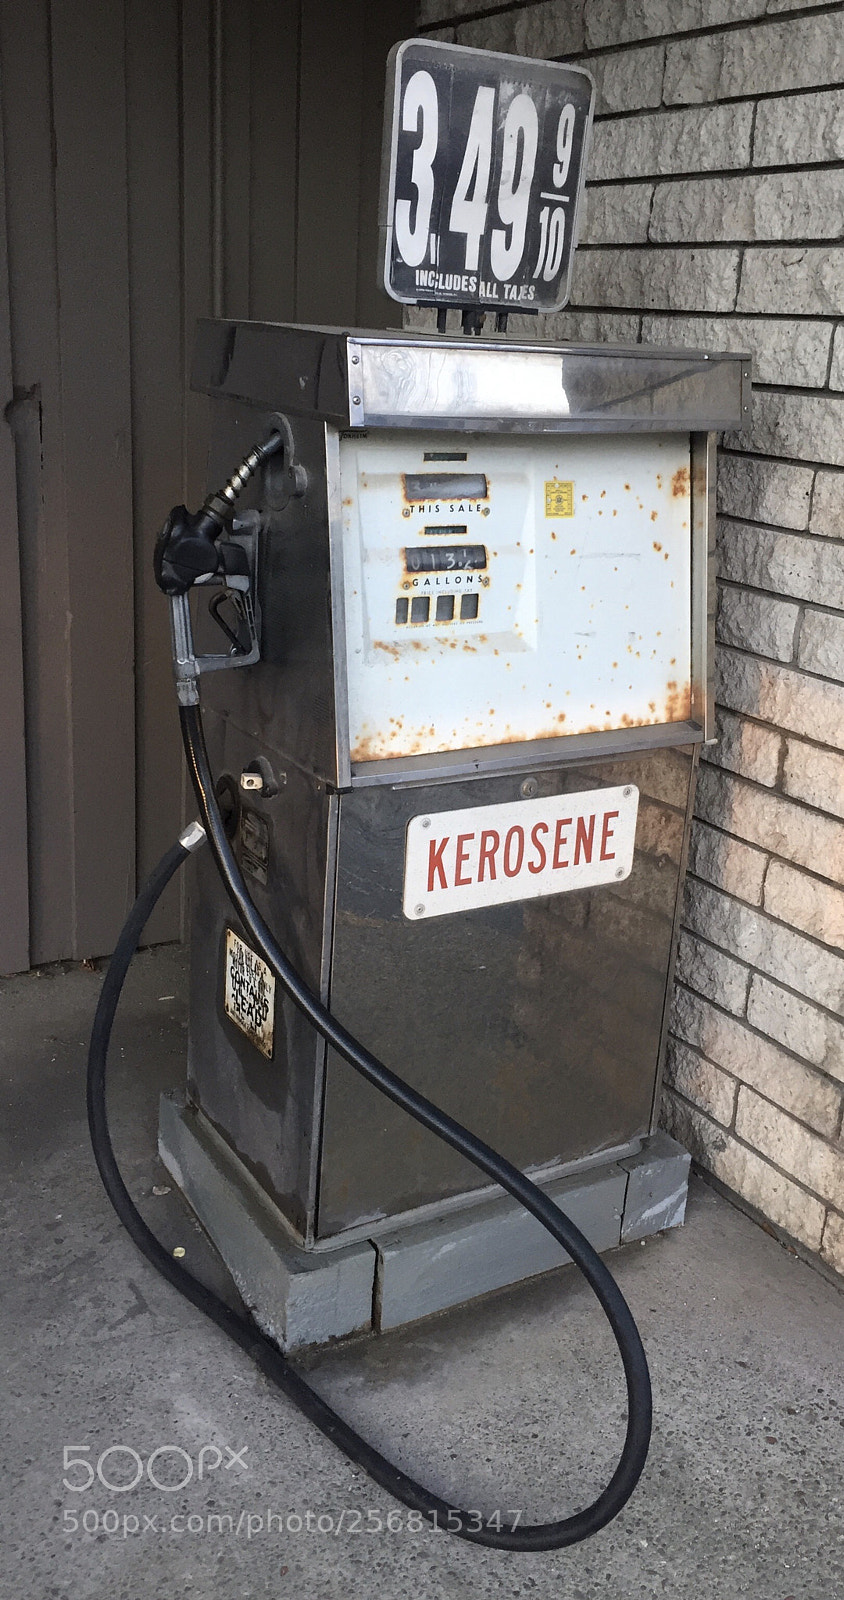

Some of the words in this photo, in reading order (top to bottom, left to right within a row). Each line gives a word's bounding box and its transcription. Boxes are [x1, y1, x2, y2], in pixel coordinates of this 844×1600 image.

[553, 103, 576, 188] 9
[533, 206, 565, 282] 10
[415, 269, 478, 293] INCLUDES
[479, 281, 499, 298] ALL
[410, 504, 440, 513] THIS
[449, 503, 481, 512] SALE
[412, 574, 483, 587] GALLONS
[427, 810, 619, 892] KEROSENE
